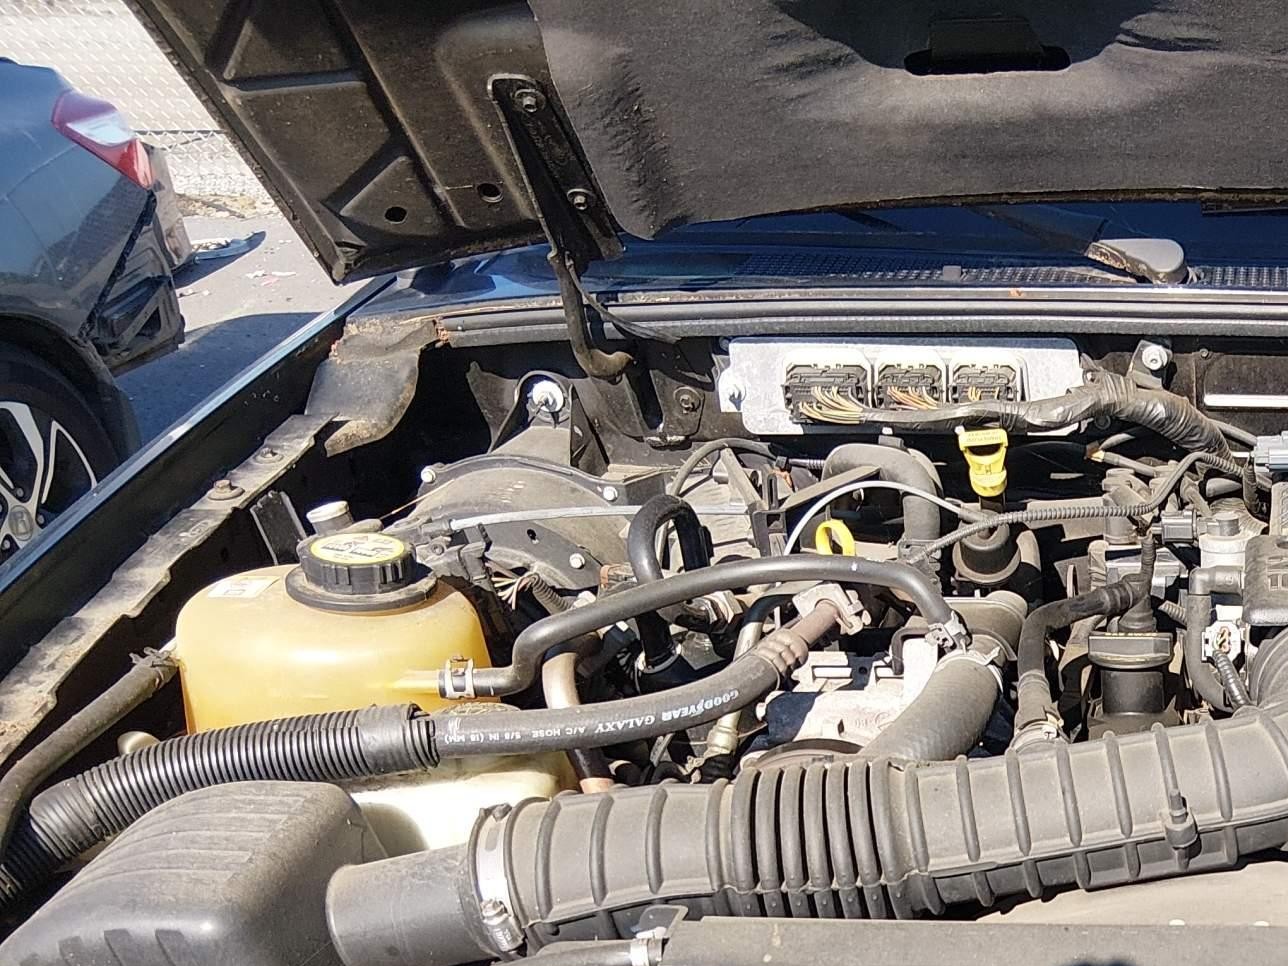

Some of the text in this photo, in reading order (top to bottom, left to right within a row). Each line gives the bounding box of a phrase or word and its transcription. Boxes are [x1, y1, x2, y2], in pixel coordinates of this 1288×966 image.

[661, 689, 740, 722] GOODYEAR
[565, 726, 586, 735] A/C
[595, 715, 656, 734] GALAXY
[532, 728, 562, 738] HOSE
